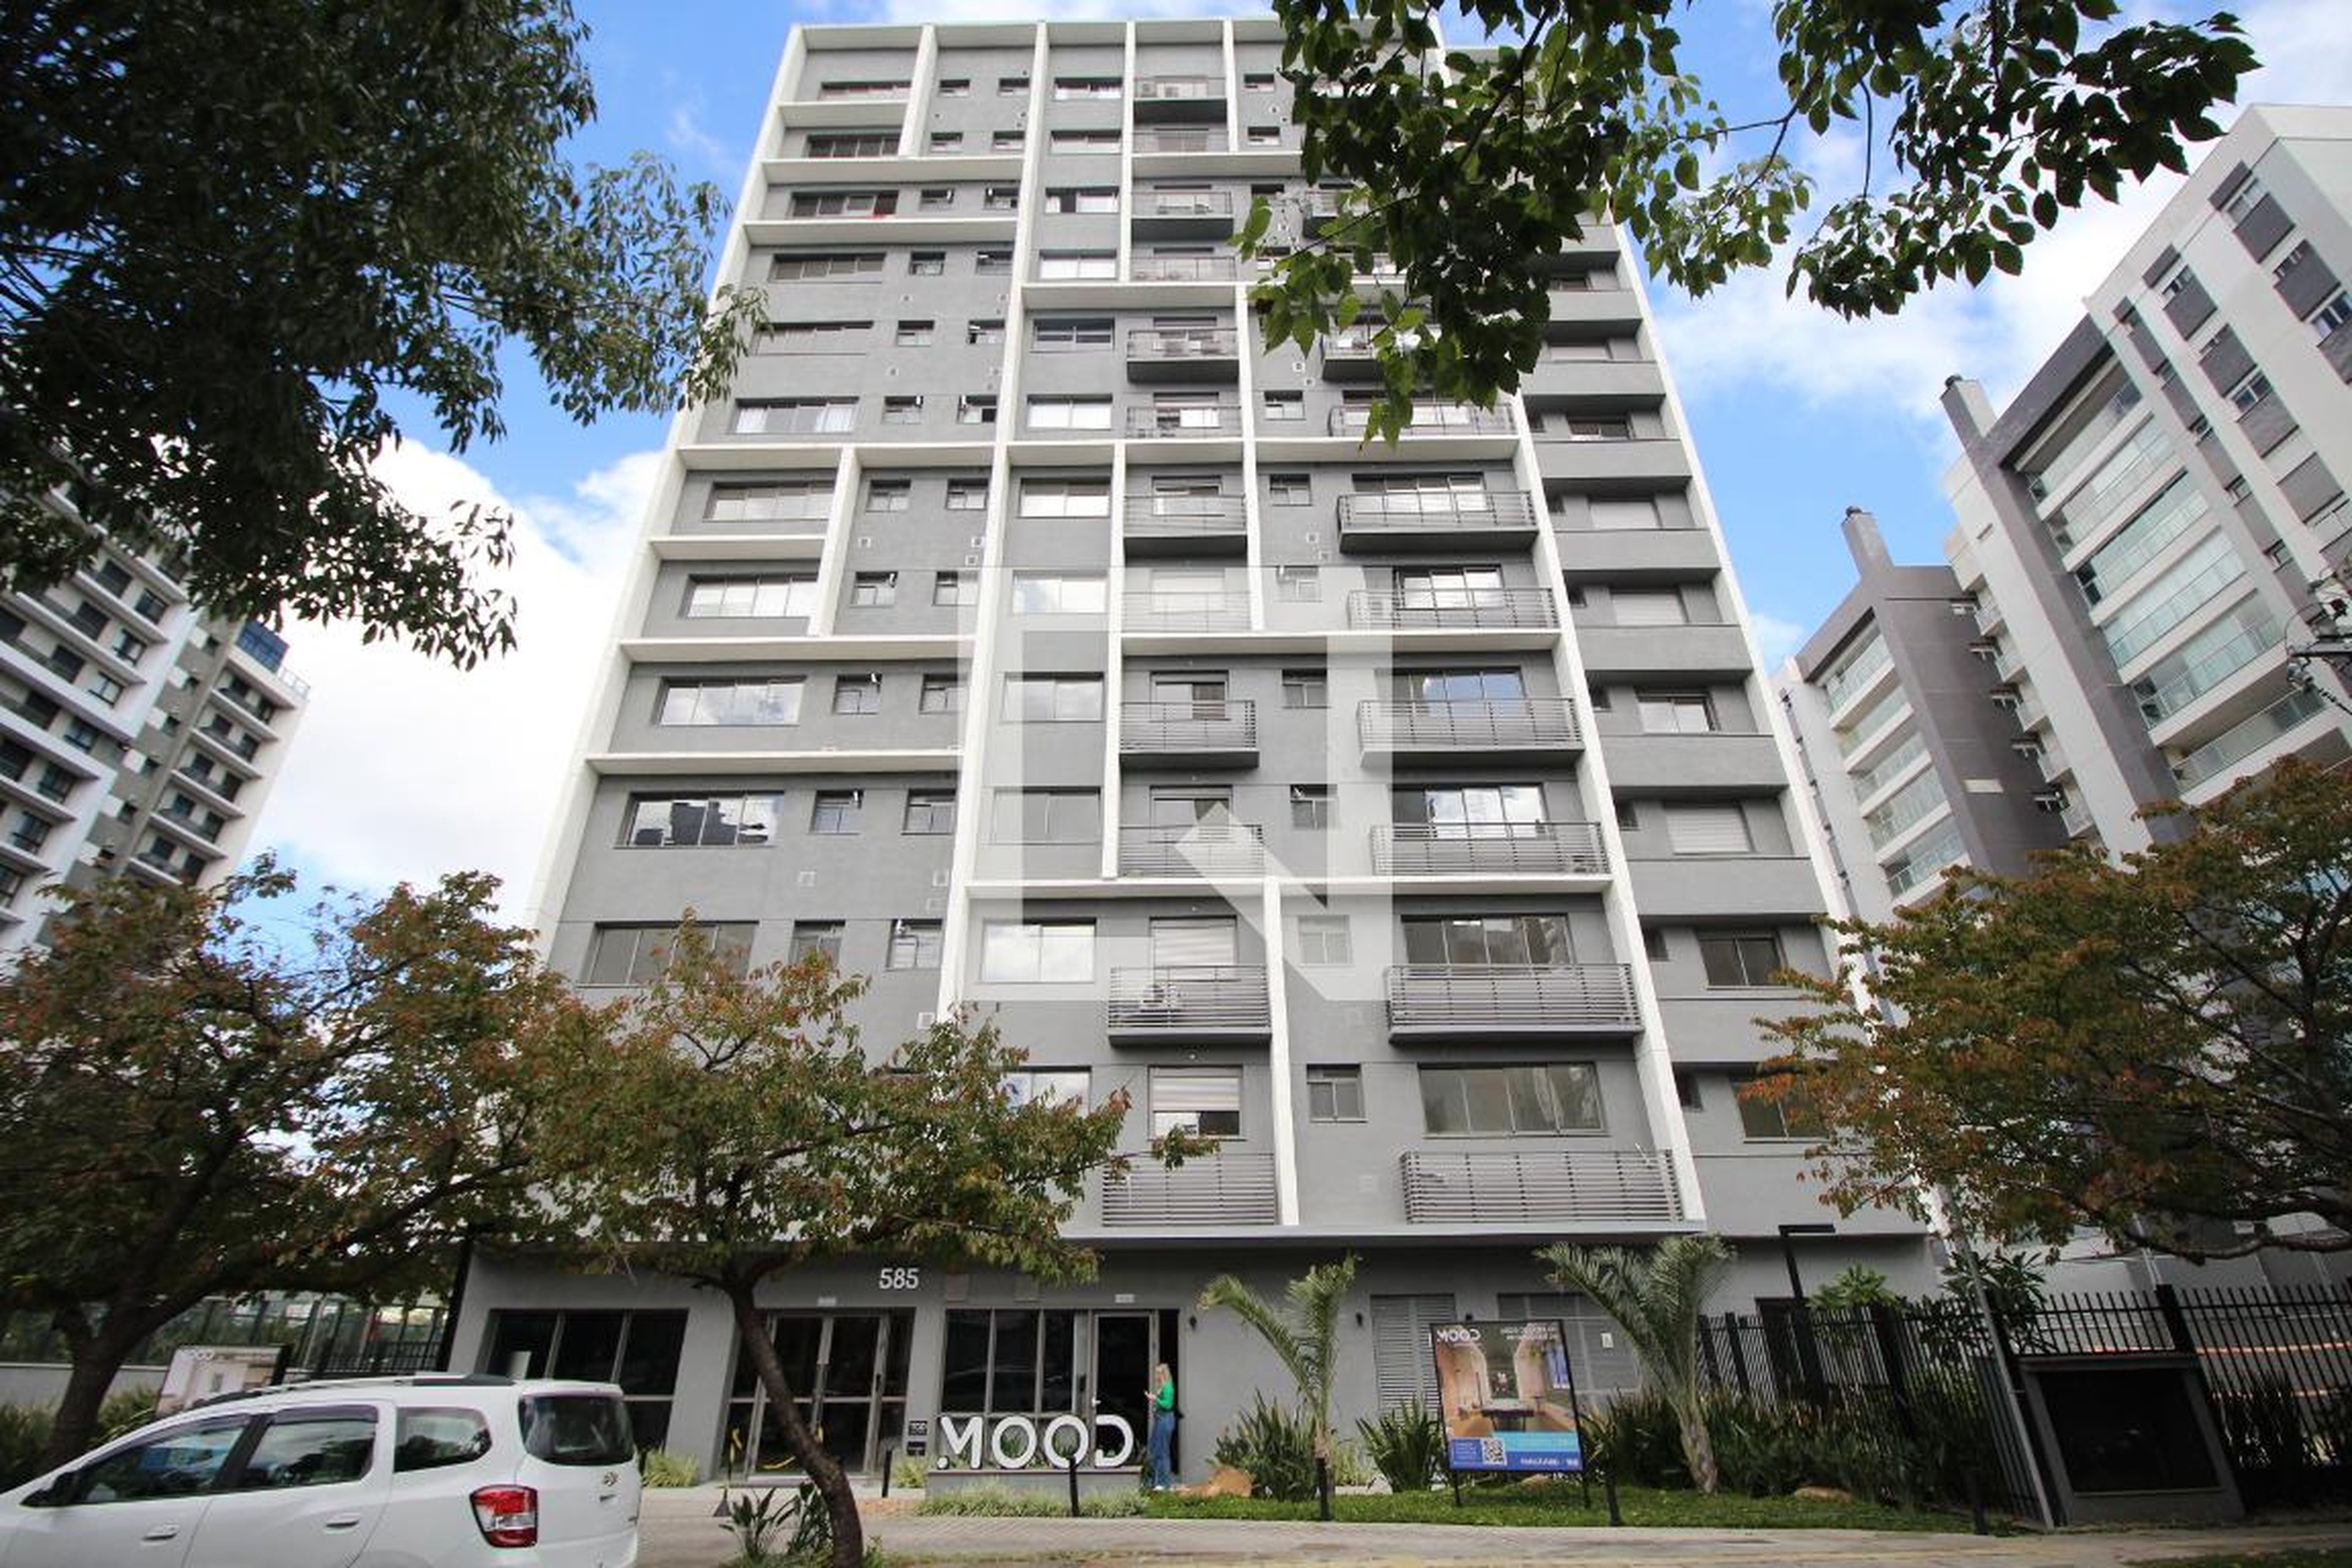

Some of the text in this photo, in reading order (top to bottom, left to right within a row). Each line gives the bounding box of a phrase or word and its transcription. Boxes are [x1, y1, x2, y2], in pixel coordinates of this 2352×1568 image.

[879, 1268, 919, 1289] 585
[1436, 1328, 1481, 1343] MOOD
[937, 1415, 1133, 1469] MOOD
